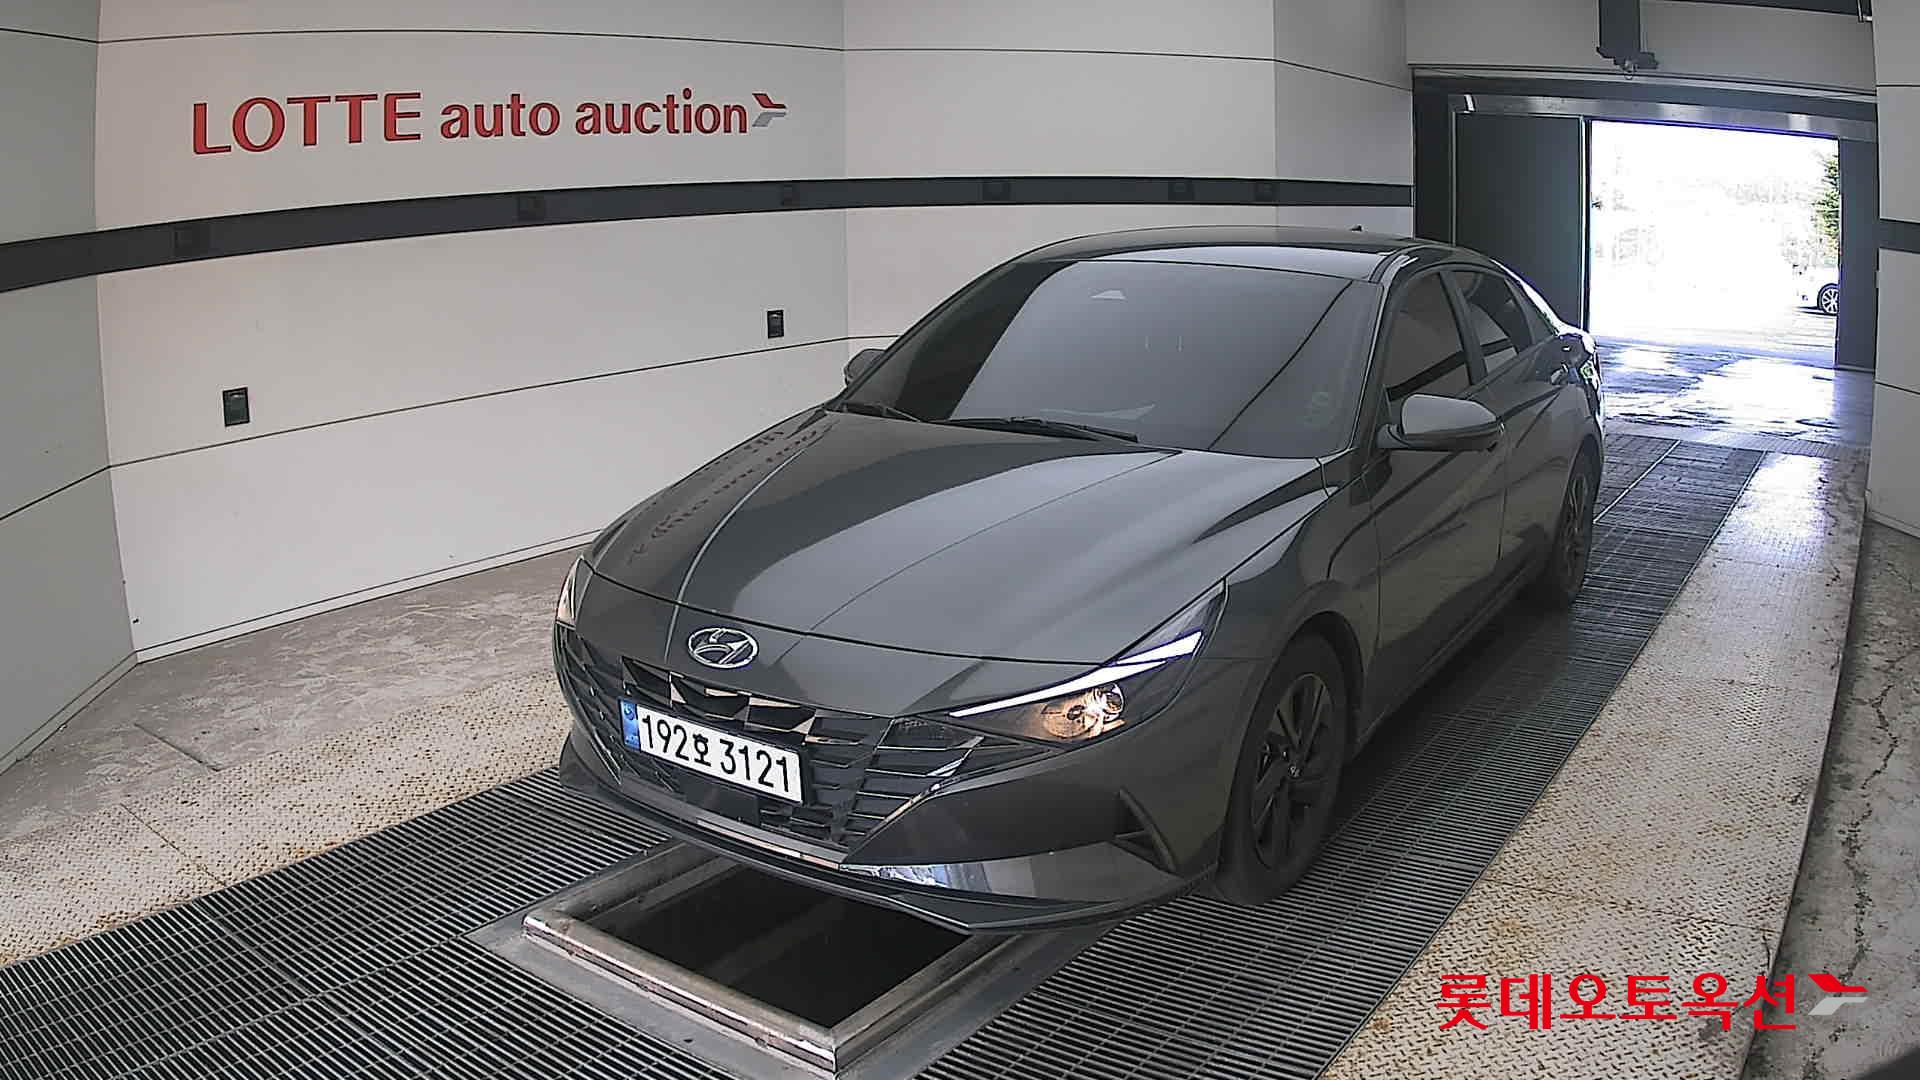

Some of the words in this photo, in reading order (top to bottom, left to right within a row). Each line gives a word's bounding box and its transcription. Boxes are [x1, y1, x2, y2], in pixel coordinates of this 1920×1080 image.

[192, 92, 422, 155] LOTTE
[440, 94, 560, 139] auto
[575, 88, 748, 135] auction
[642, 714, 712, 767] 192호
[718, 738, 790, 793] 3121
